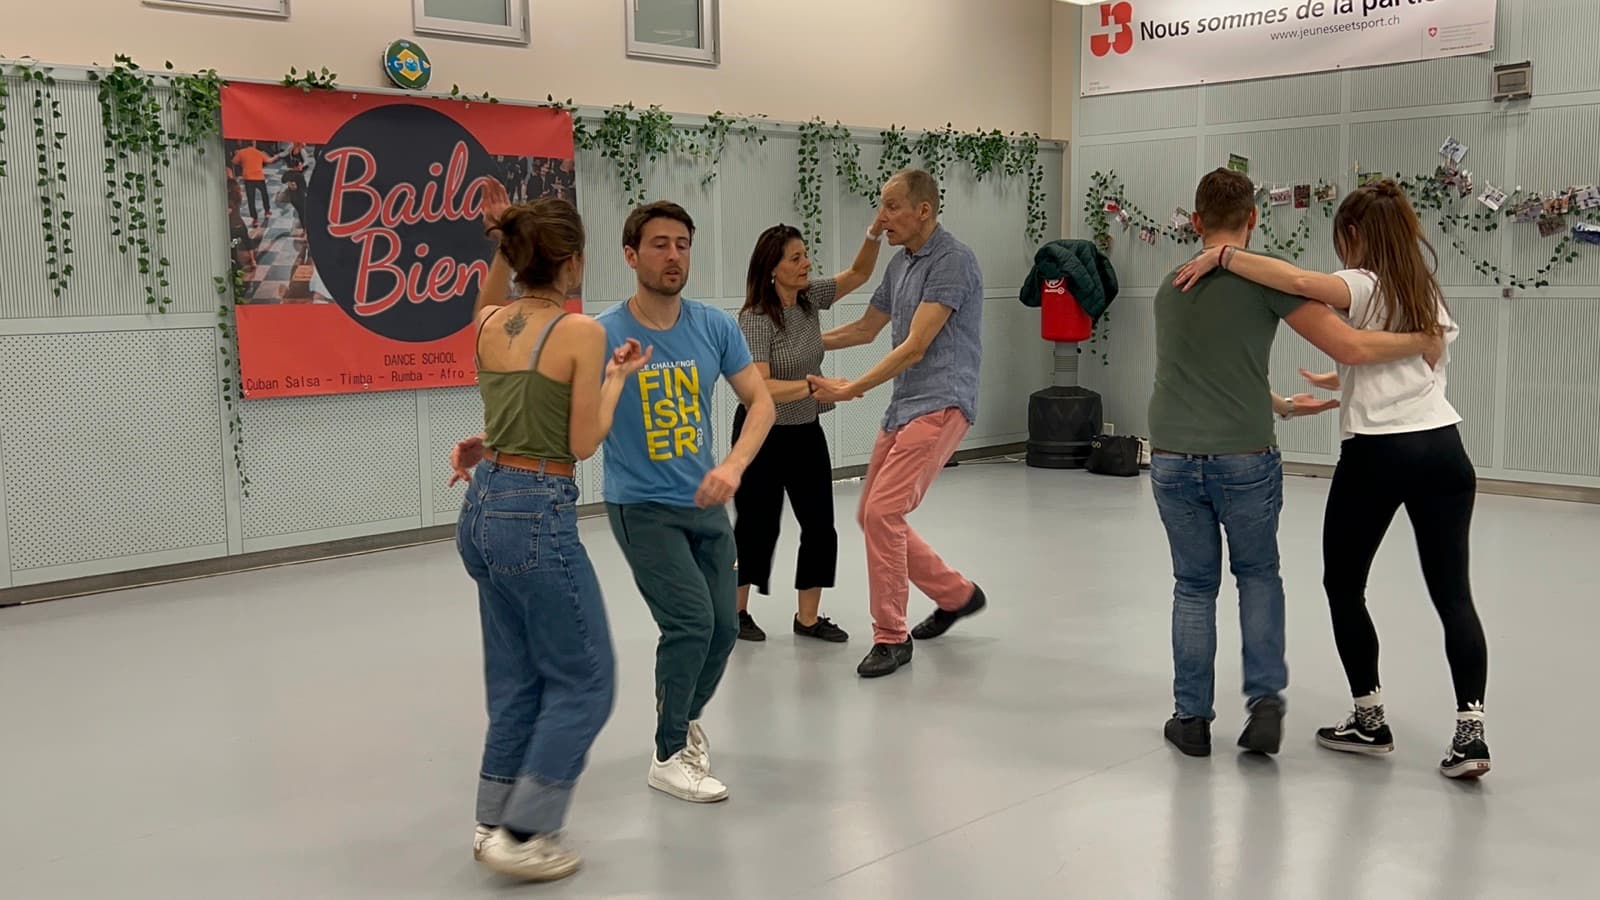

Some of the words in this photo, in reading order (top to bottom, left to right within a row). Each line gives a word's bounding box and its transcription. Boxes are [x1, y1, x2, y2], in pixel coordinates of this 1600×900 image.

[1140, 20, 1190, 41] Nous
[1196, 7, 1289, 34] sommes
[1296, 0, 1325, 19] de
[1333, 0, 1353, 15] la
[1270, 15, 1400, 40] www.jeunesseetsport.ch
[324, 140, 490, 238] Baila
[351, 227, 489, 316] Bien
[384, 353, 416, 367] DANCE
[422, 351, 457, 365] SCHOOL
[246, 377, 279, 391] Cuban
[285, 375, 320, 389] Salsa
[340, 372, 373, 385] Timba
[391, 370, 422, 383] Rumba
[440, 368, 465, 380] Afro
[638, 366, 699, 402] FIN
[642, 394, 701, 430] ISH
[646, 426, 699, 461] ER
